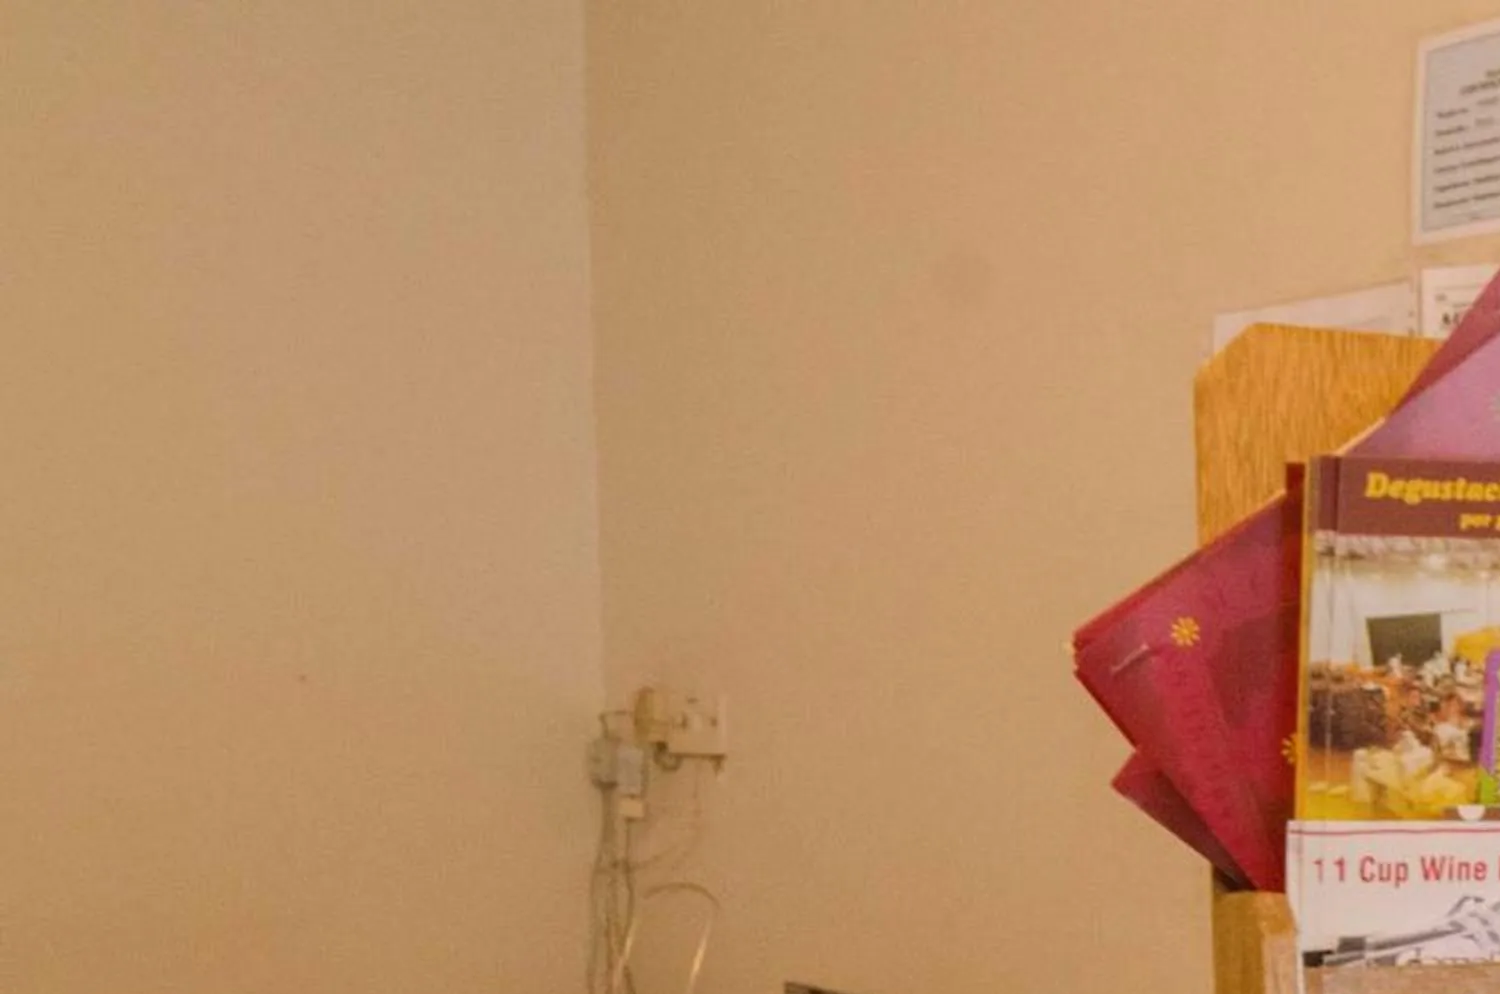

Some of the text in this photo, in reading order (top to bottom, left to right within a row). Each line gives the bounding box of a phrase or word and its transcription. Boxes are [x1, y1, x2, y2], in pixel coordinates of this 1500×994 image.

[1460, 513, 1491, 531] por
[1359, 855, 1410, 888] Cup
[1420, 855, 1488, 882] Wine
